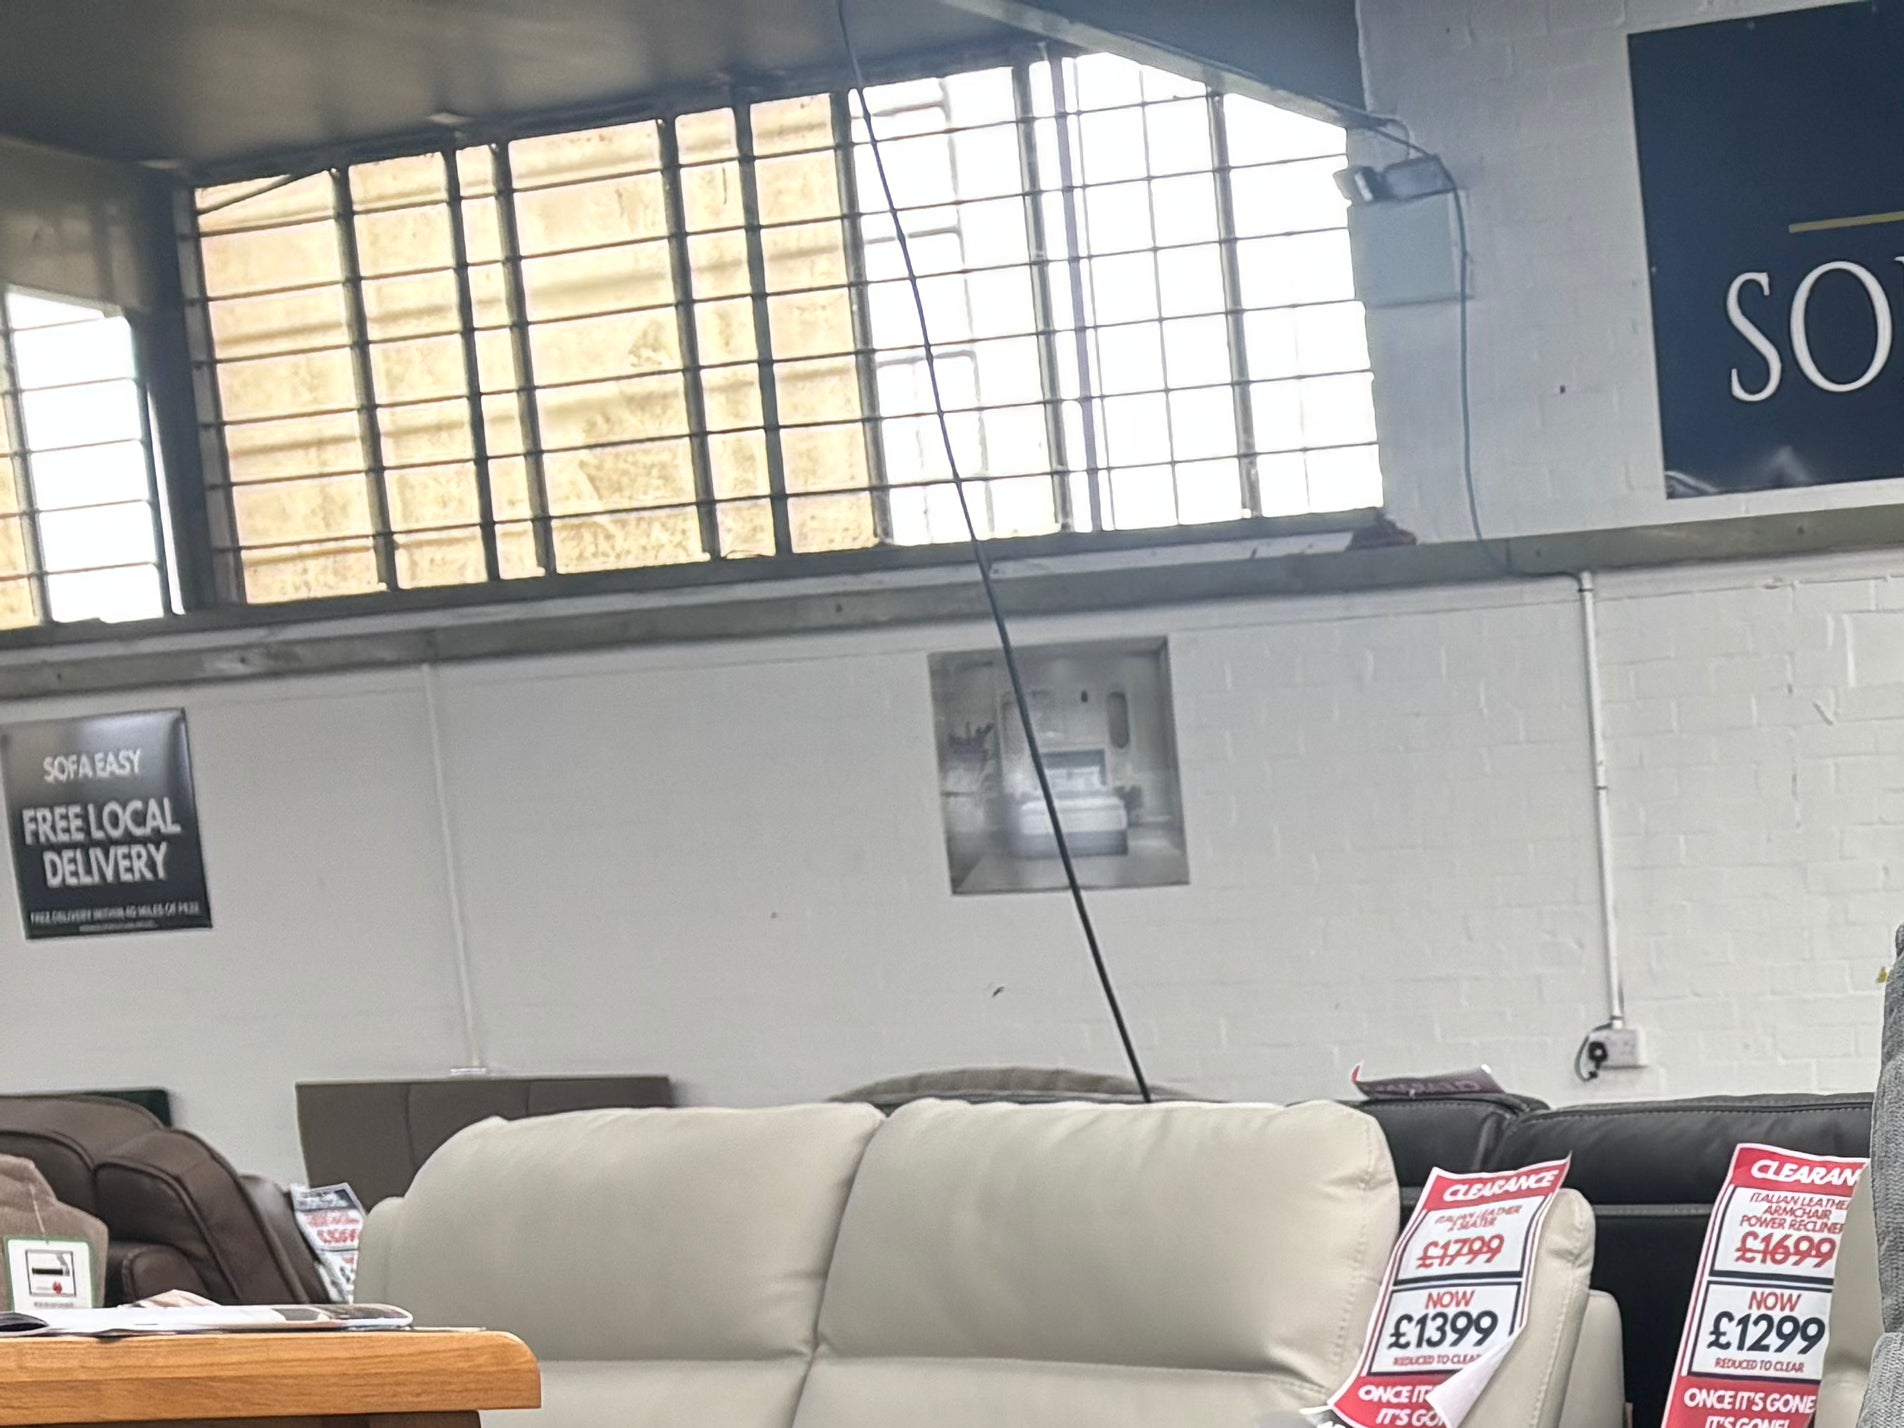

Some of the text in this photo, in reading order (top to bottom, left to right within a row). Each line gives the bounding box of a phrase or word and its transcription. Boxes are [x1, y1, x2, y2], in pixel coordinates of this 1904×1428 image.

[43, 747, 142, 783] SOFA EASY
[22, 797, 182, 845] FREE LOCAL
[42, 841, 168, 888] DELIVERY
[1443, 1169, 1560, 1202] CLEARANCE
[1750, 1159, 1861, 1187] CLEARAN
[1749, 1192, 1848, 1211] ITALIAN LEATHE
[1762, 1205, 1832, 1221] ARMCHAIR
[1740, 1214, 1787, 1230] POWER
[1416, 1234, 1505, 1269] £1799
[1734, 1230, 1837, 1268] £1699
[1424, 1289, 1475, 1310] NOW
[1748, 1290, 1802, 1313] NOW
[1387, 1310, 1499, 1350] £1399
[1706, 1310, 1826, 1355] £1299
[1450, 1353, 1481, 1365] CLEA
[1759, 1359, 1772, 1371] TO
[1773, 1360, 1805, 1373] CLEAR
[1358, 1384, 1412, 1403] ONCE
[1683, 1387, 1817, 1414] ONCE IT'S GONE
[1376, 1407, 1411, 1426] IT'S
